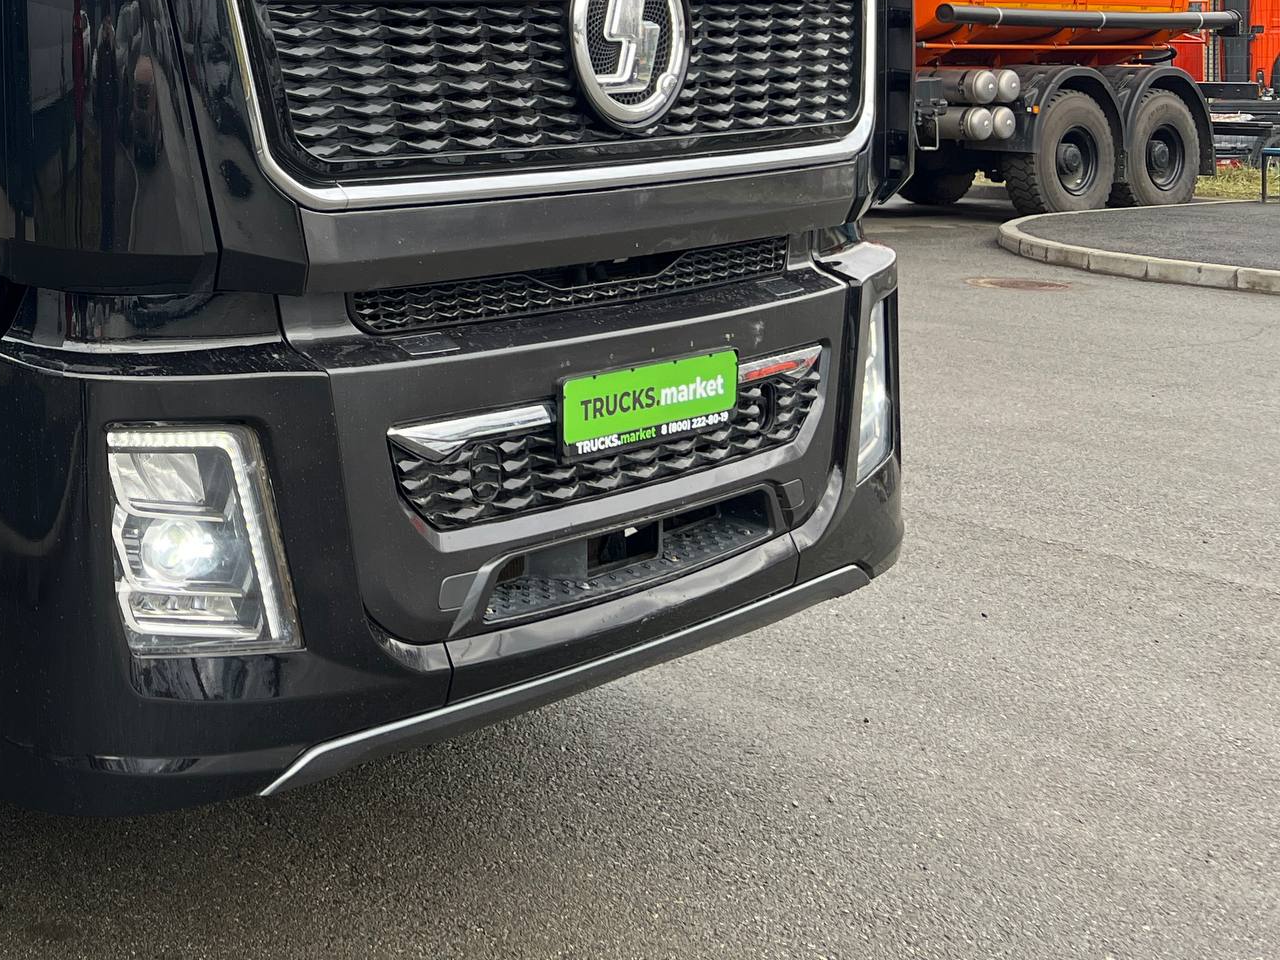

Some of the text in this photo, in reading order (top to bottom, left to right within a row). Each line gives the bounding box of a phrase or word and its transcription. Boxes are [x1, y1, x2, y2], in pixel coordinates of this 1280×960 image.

[581, 374, 724, 421] TRUCKS.market
[576, 411, 729, 454] TRUCKS.market 8 (800) 222-80-19
